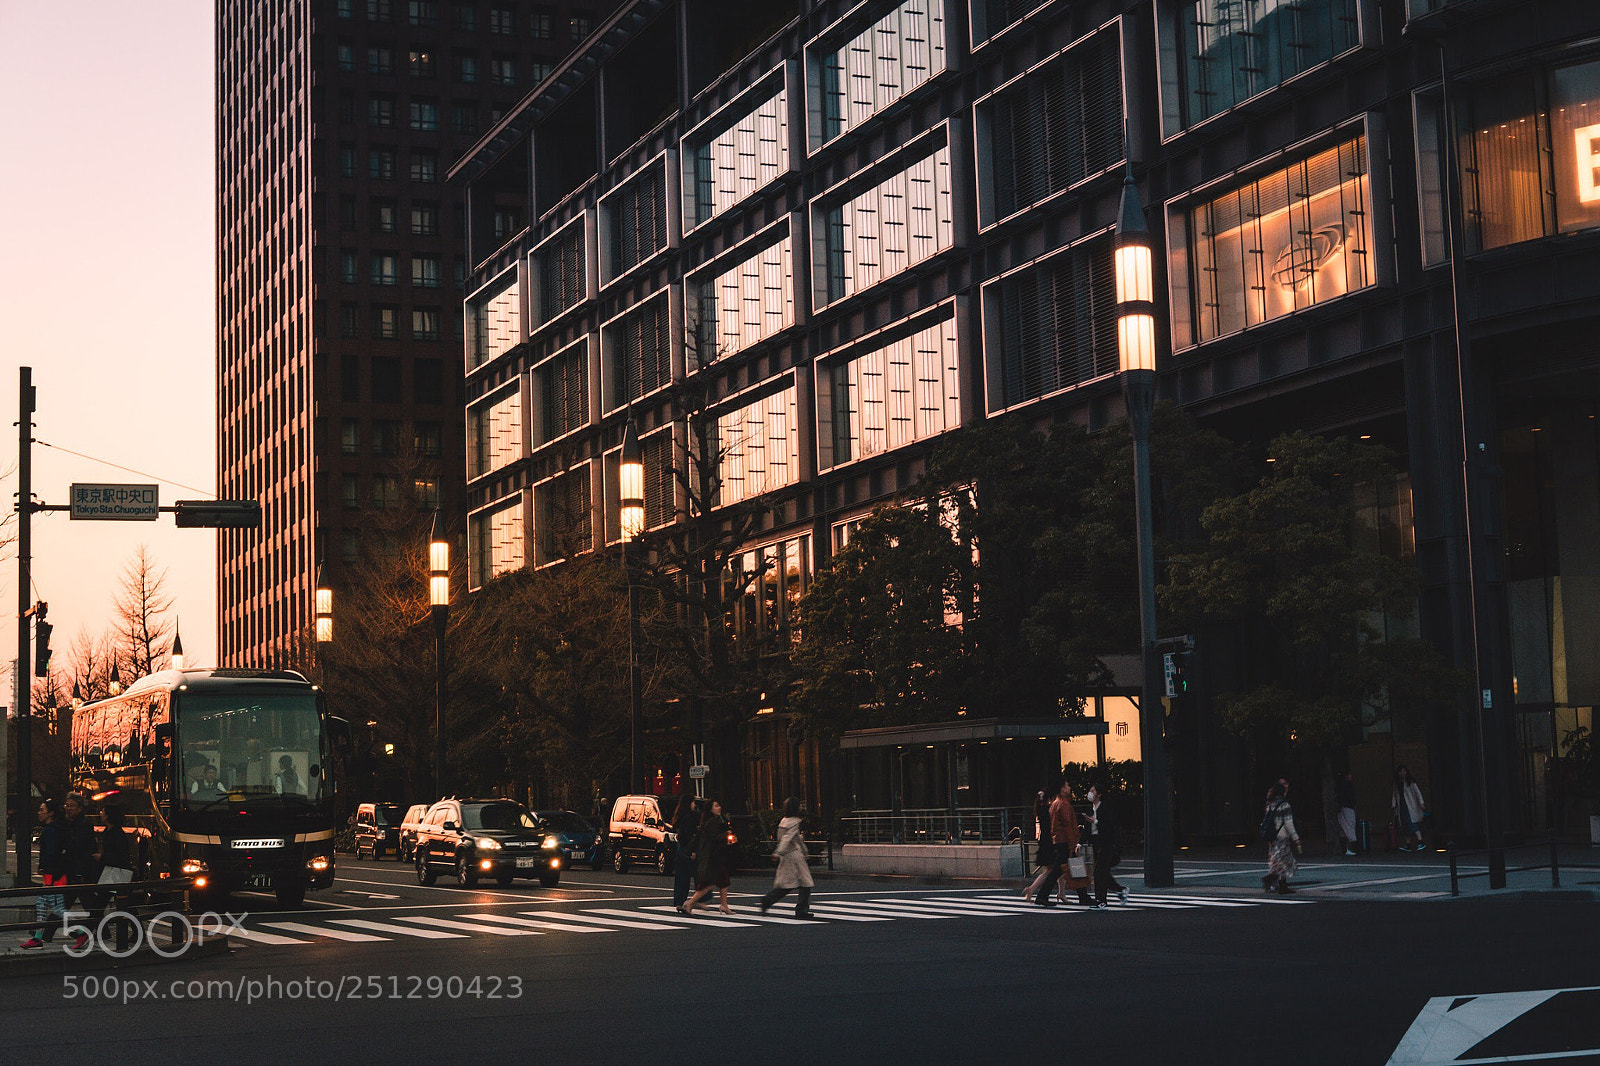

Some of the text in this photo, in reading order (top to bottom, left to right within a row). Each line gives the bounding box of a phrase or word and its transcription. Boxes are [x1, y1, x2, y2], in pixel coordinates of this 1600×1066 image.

[76, 488, 154, 504] 東京駅中央口
[76, 505, 99, 515] Tokyo
[114, 505, 155, 515] Chuoguchi
